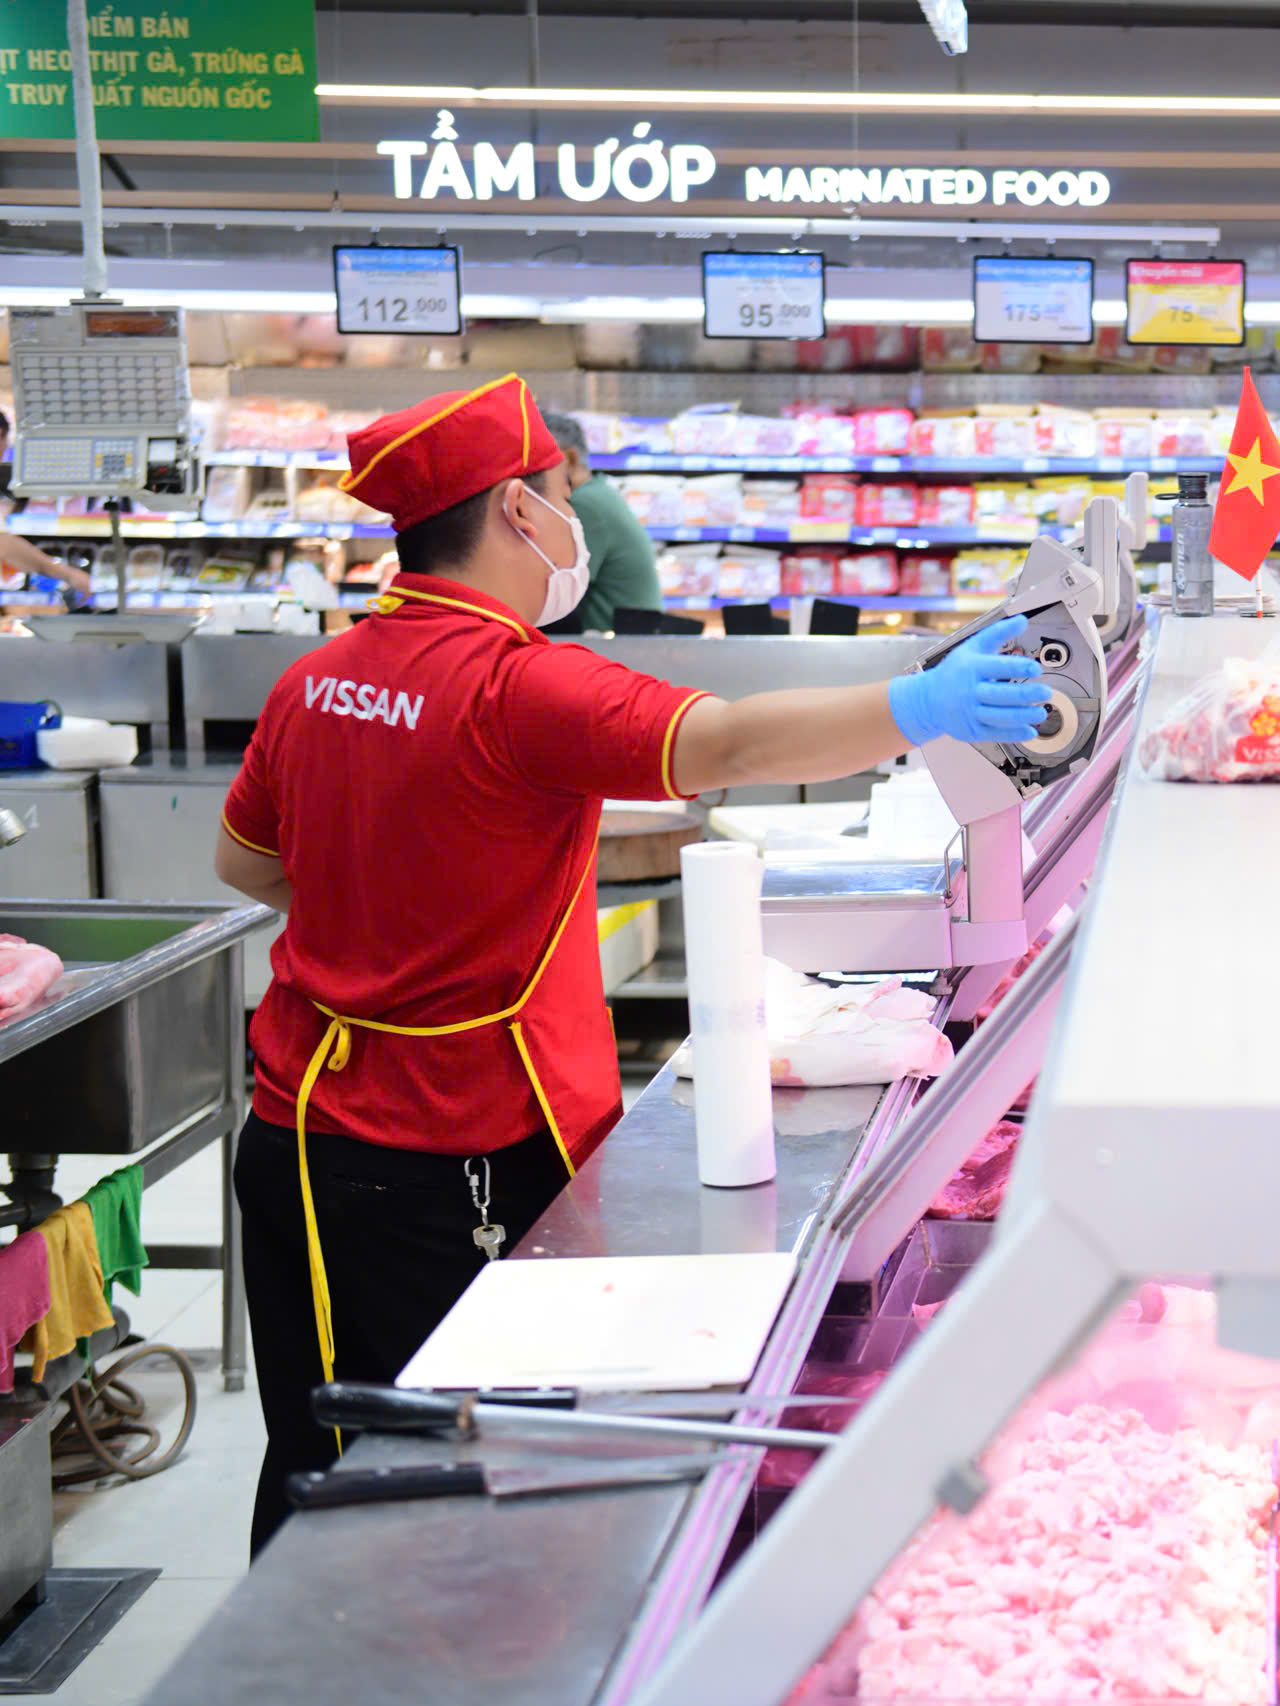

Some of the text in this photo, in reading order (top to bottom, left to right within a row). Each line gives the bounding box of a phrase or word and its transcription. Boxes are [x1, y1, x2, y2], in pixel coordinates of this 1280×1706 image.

[86, 4, 190, 38] IỂM BÁN
[0, 48, 19, 75] ỊT
[88, 50, 139, 77] THỊT
[147, 46, 184, 77] GÀ,
[191, 48, 269, 75] TRỨNG
[274, 48, 304, 75] GÀ
[6, 83, 67, 105] TRUY
[91, 77, 135, 106] UẤT
[225, 79, 272, 109] GỐC
[558, 121, 717, 203] ƯỚP
[745, 166, 1111, 207] MARINATED FOOD
[305, 675, 425, 730] VISSAN
